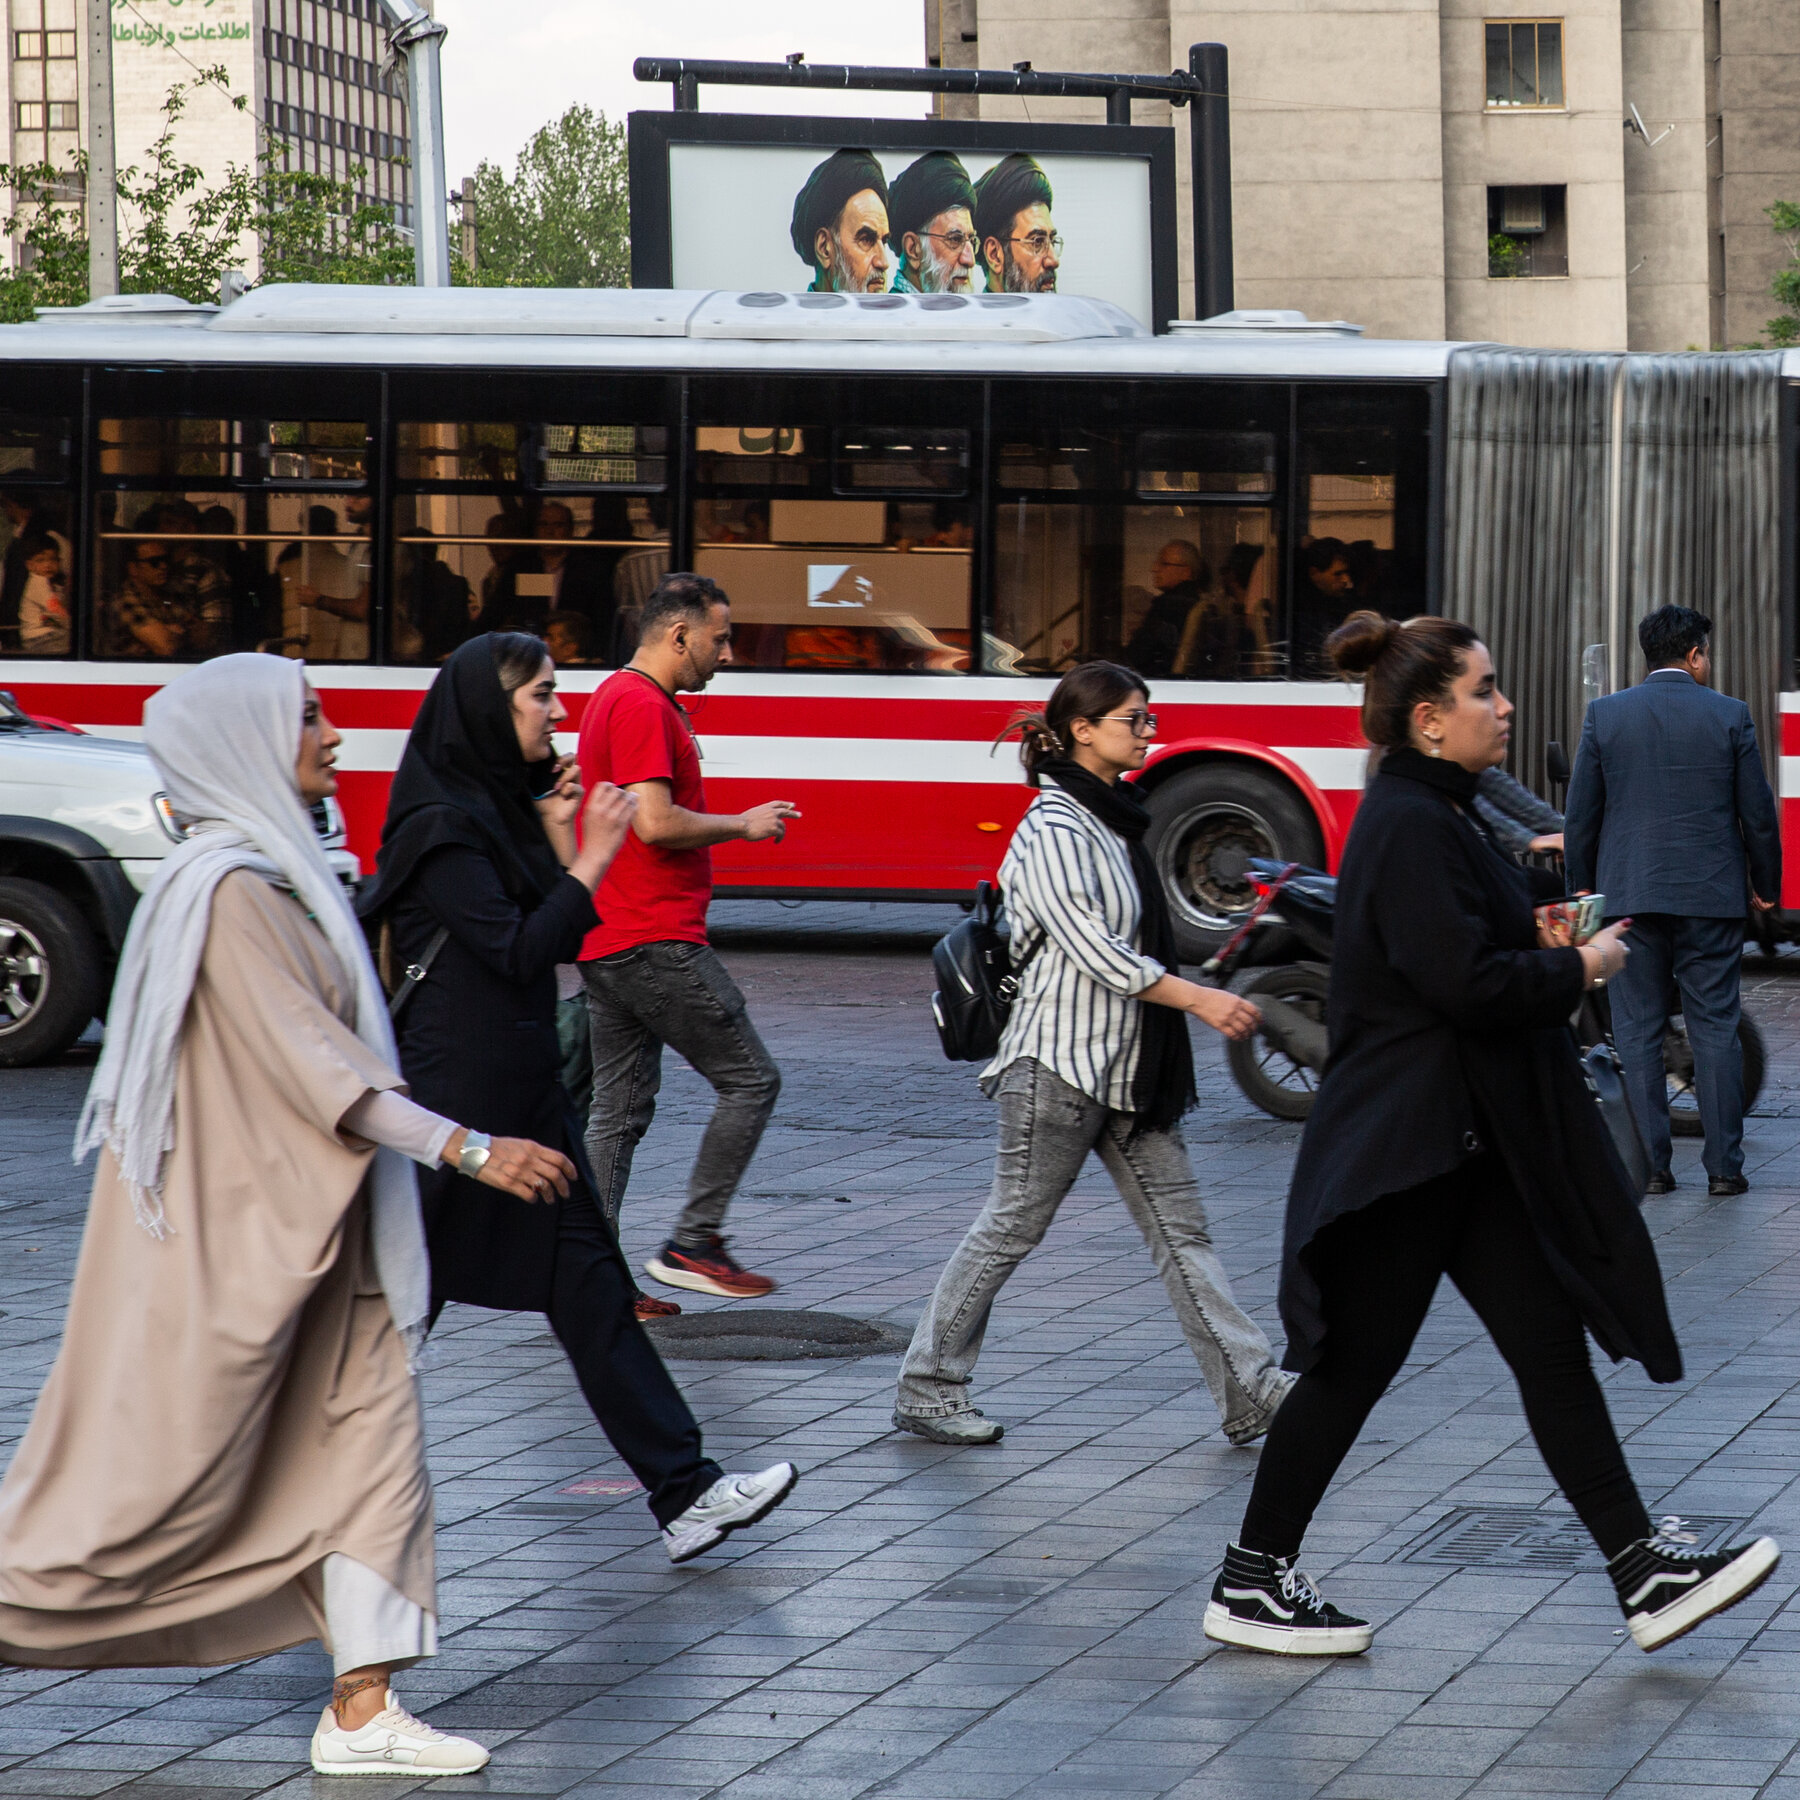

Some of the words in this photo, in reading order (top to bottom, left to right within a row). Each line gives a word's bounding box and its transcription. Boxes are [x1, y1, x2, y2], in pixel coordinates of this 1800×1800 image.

[112, 22, 163, 47] ارتباطا
[163, 31, 176, 47] و
[179, 22, 250, 40] اطلاعات
